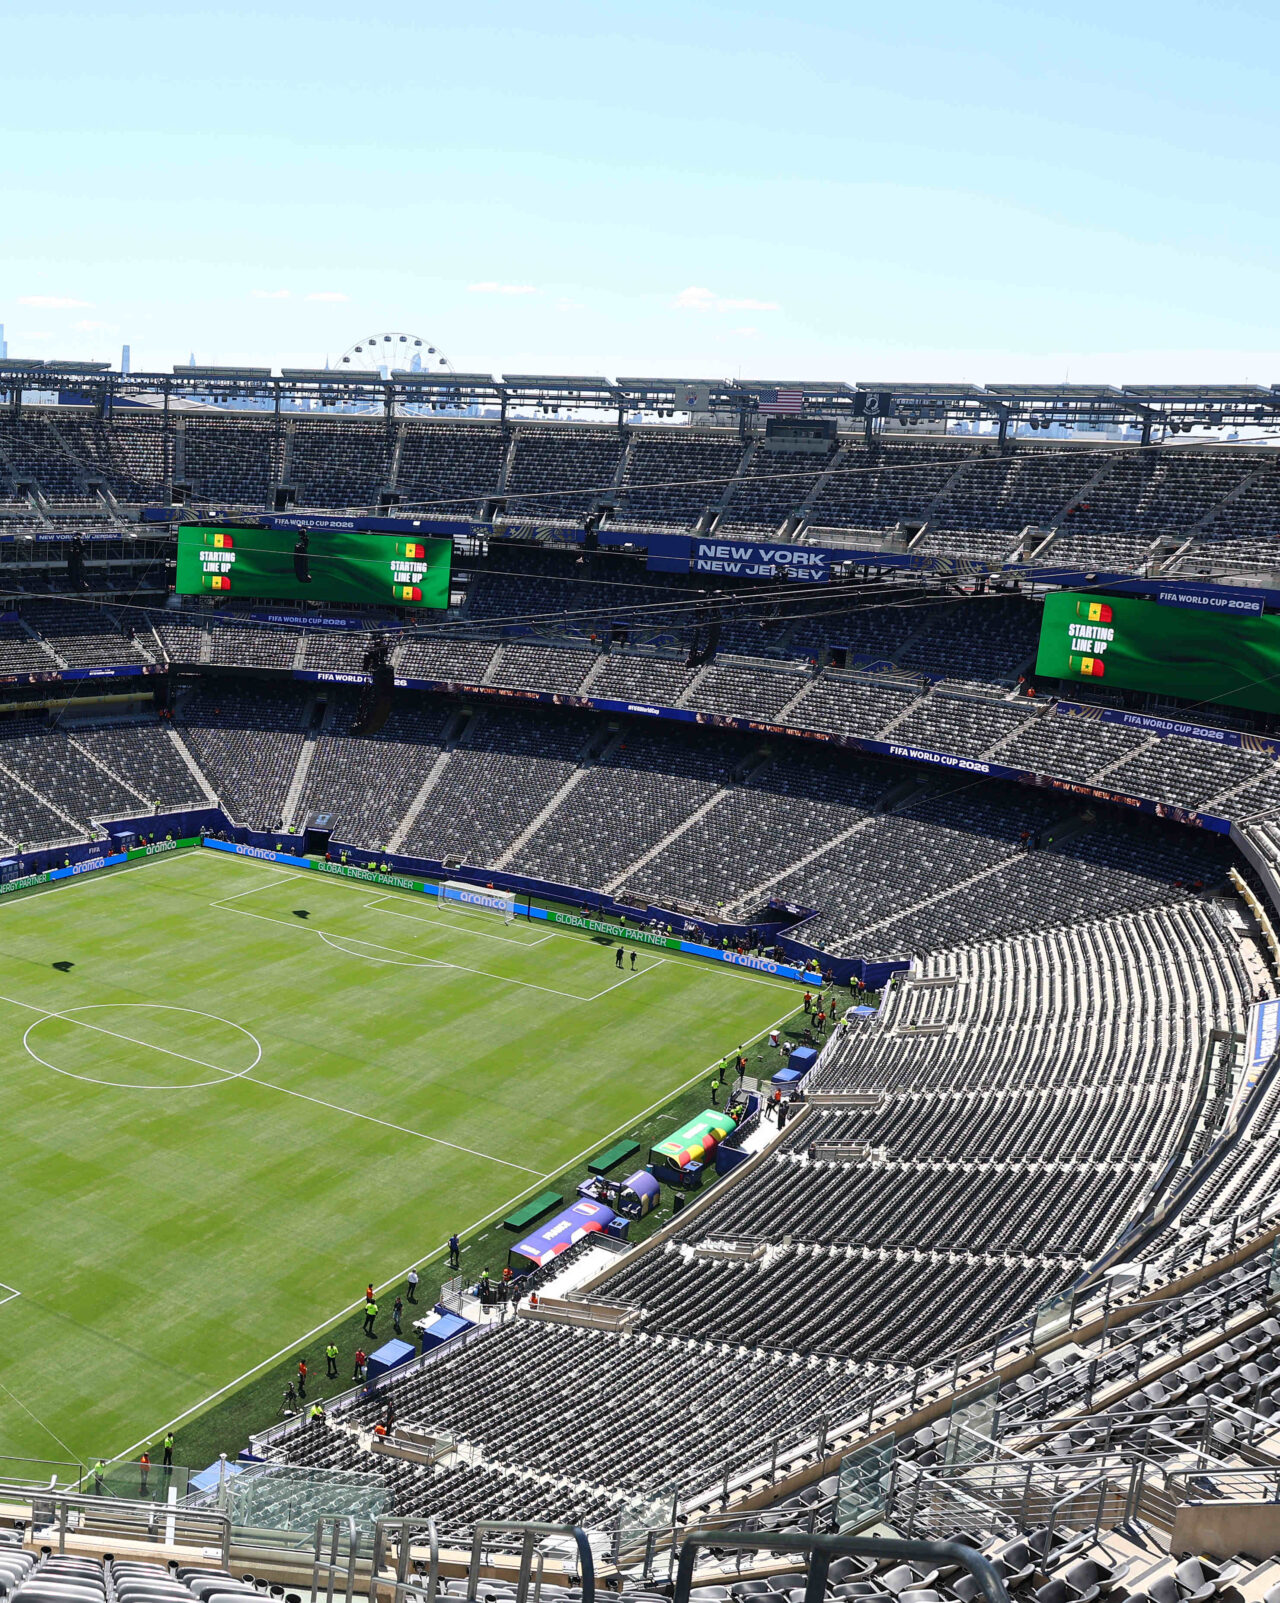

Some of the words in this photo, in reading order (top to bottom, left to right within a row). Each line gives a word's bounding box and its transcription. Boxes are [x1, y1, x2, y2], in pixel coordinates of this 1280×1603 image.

[200, 551, 236, 562] STARTING
[698, 544, 753, 560] NEW
[758, 549, 826, 566] YORK
[203, 562, 220, 572] LINE
[220, 562, 231, 573] UP
[390, 560, 428, 573] STARTING
[697, 560, 742, 573] NEW
[394, 572, 411, 582] LINE
[412, 572, 423, 583] UP
[1160, 592, 1178, 601] FIFA
[1178, 594, 1209, 605] WORLD
[1210, 598, 1228, 607] CUP
[1228, 600, 1260, 611] 2026
[1068, 623, 1114, 641] STARTING
[1072, 638, 1093, 652] LINE
[1093, 641, 1108, 654] UP
[335, 674, 363, 683] WORLD
[1123, 714, 1142, 725] FIFA
[1142, 717, 1173, 731] WORLD
[1173, 723, 1192, 734] CUP
[1192, 727, 1224, 740] 2026
[890, 746, 908, 756] FIFA
[909, 749, 940, 762] WORLD
[941, 756, 958, 766] CUP
[958, 760, 990, 773] 2026
[1053, 780, 1070, 790] NEW
[1071, 785, 1092, 795] YORK
[1093, 790, 1111, 800] NEW
[1111, 795, 1142, 807] JERSEY
[146, 840, 177, 855] aramco
[236, 845, 276, 861] aramco
[72, 859, 105, 875] aramco
[20, 874, 46, 890] PARTNER
[318, 862, 346, 875] GLOBAL
[347, 867, 376, 882] ENERGY
[378, 873, 414, 889] PARTNER
[460, 891, 507, 910] aramco
[555, 913, 587, 929] GLOBAL
[589, 921, 625, 937] ENERGY
[625, 929, 667, 947] PARTNER
[723, 952, 777, 973] aramco
